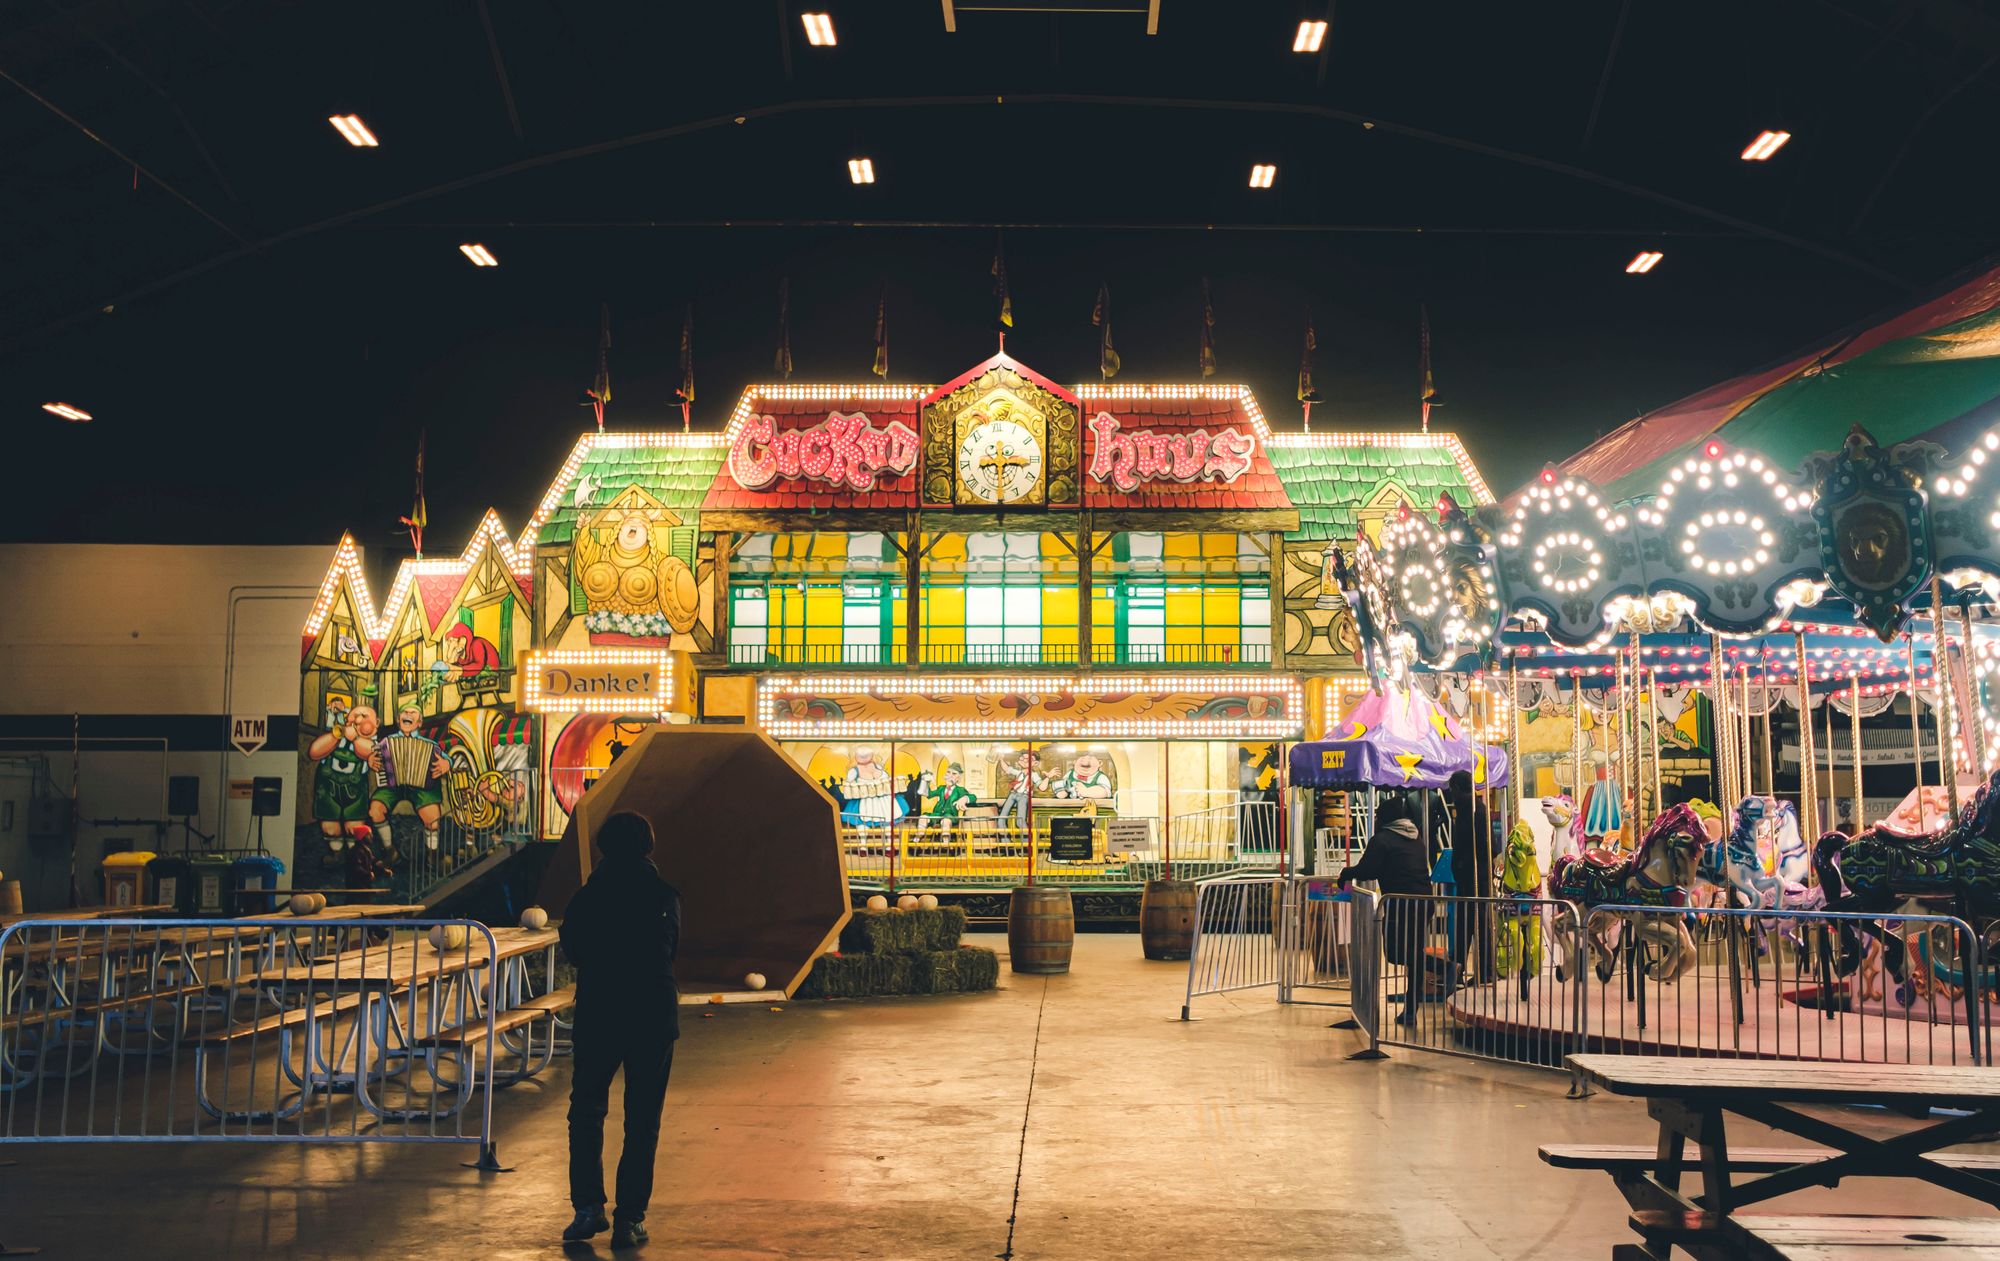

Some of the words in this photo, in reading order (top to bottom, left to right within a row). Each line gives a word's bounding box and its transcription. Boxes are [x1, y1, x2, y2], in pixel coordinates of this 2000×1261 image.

[544, 667, 651, 697] Danke!
[234, 720, 265, 737] ATM
[1322, 750, 1345, 768] EXIT
